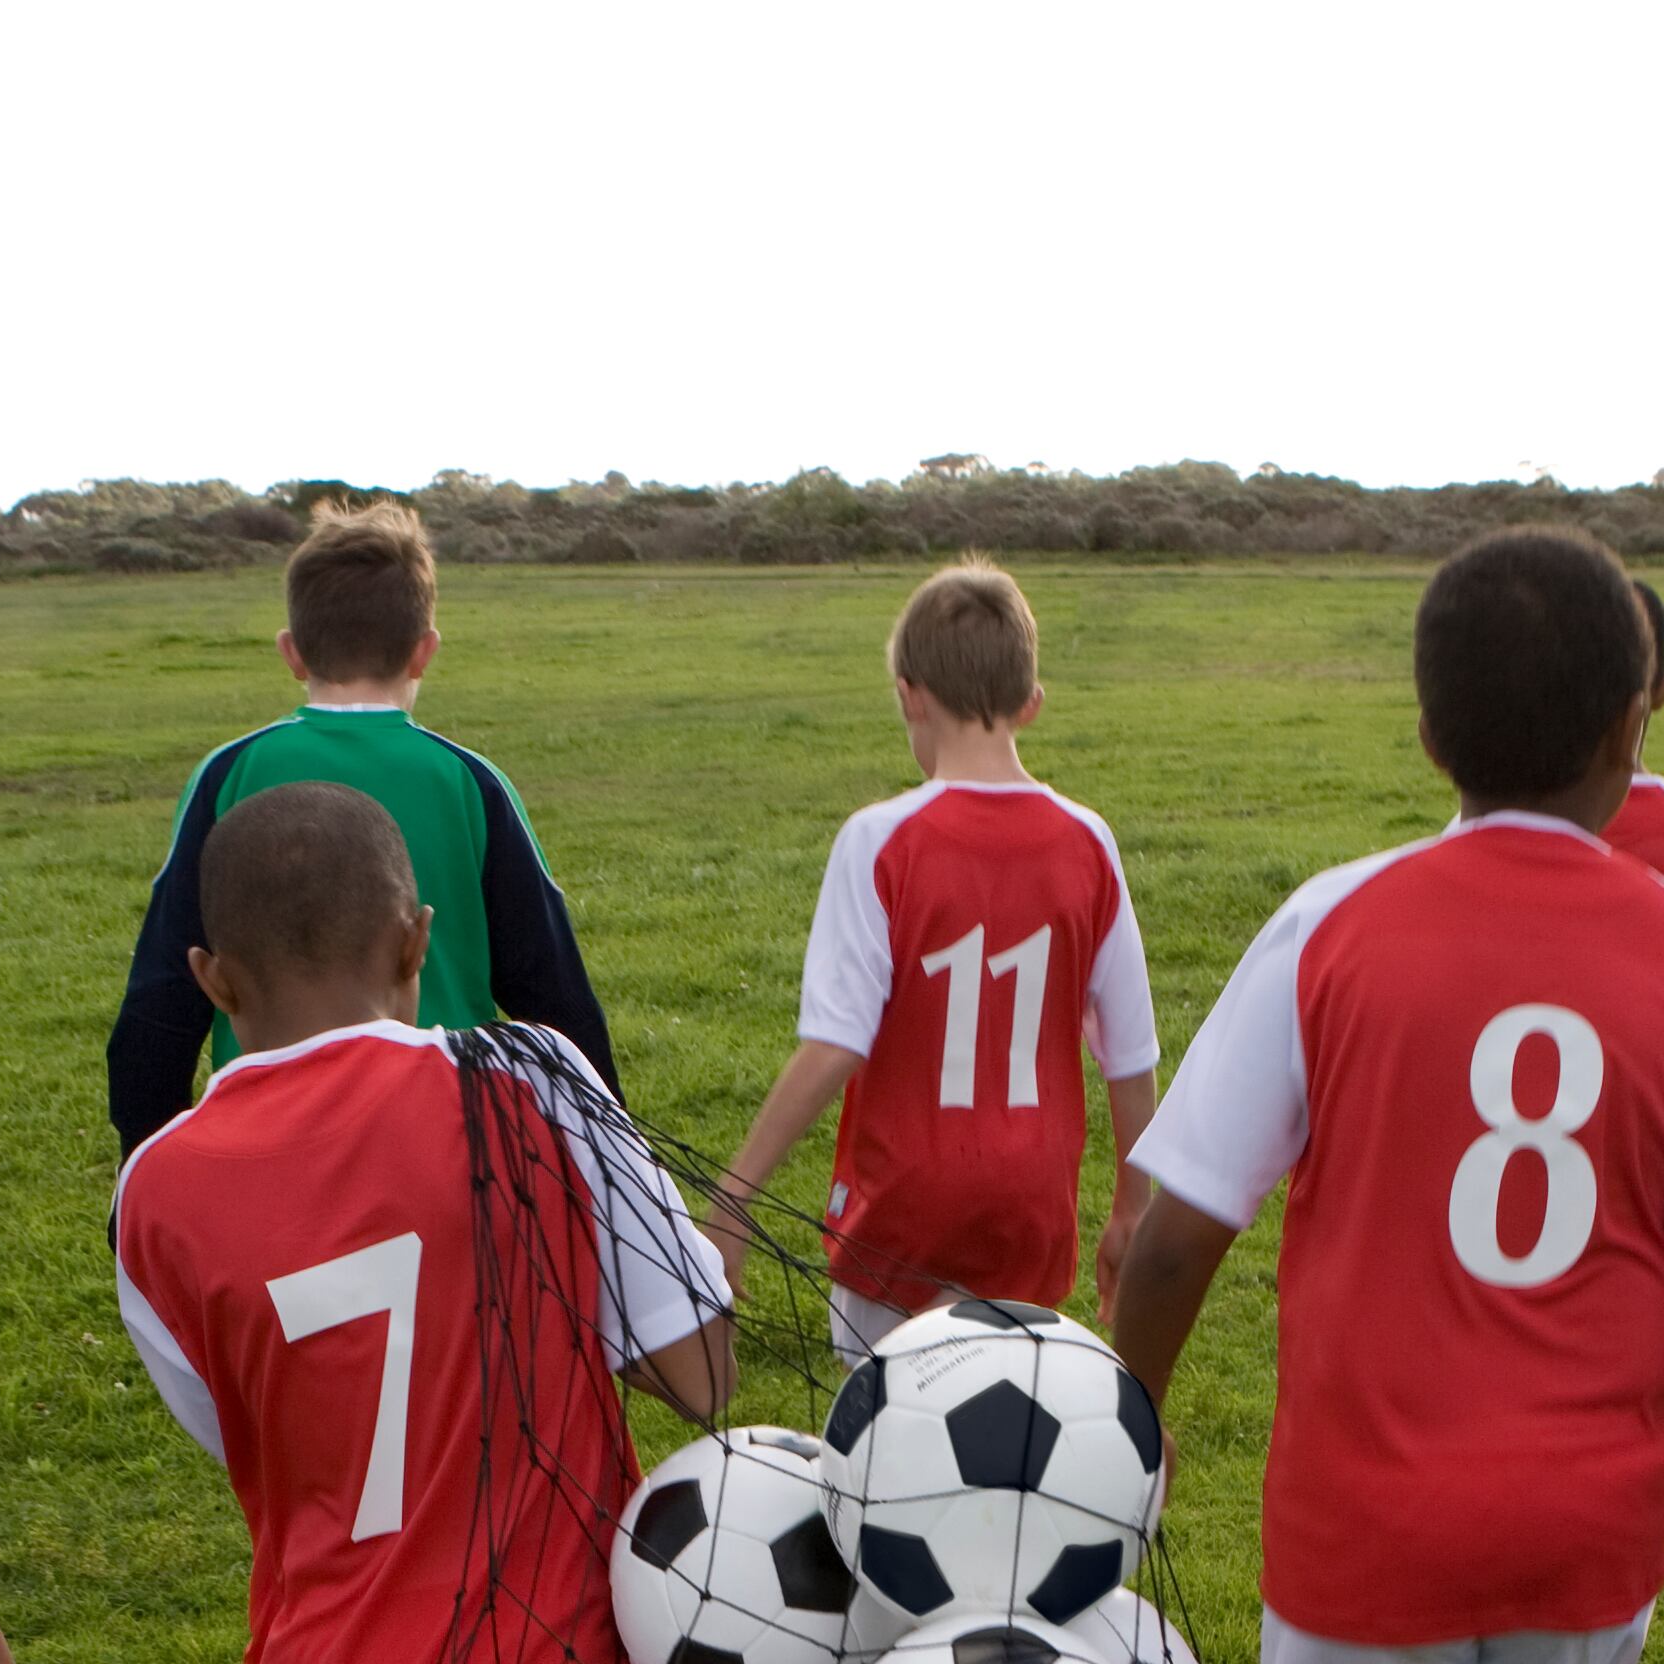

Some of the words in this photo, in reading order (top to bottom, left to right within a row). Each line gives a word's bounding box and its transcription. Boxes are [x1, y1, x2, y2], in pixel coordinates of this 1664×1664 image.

[922, 925, 1051, 1107] 11
[1449, 1004, 1603, 1287] 8
[266, 1232, 422, 1541] 7
